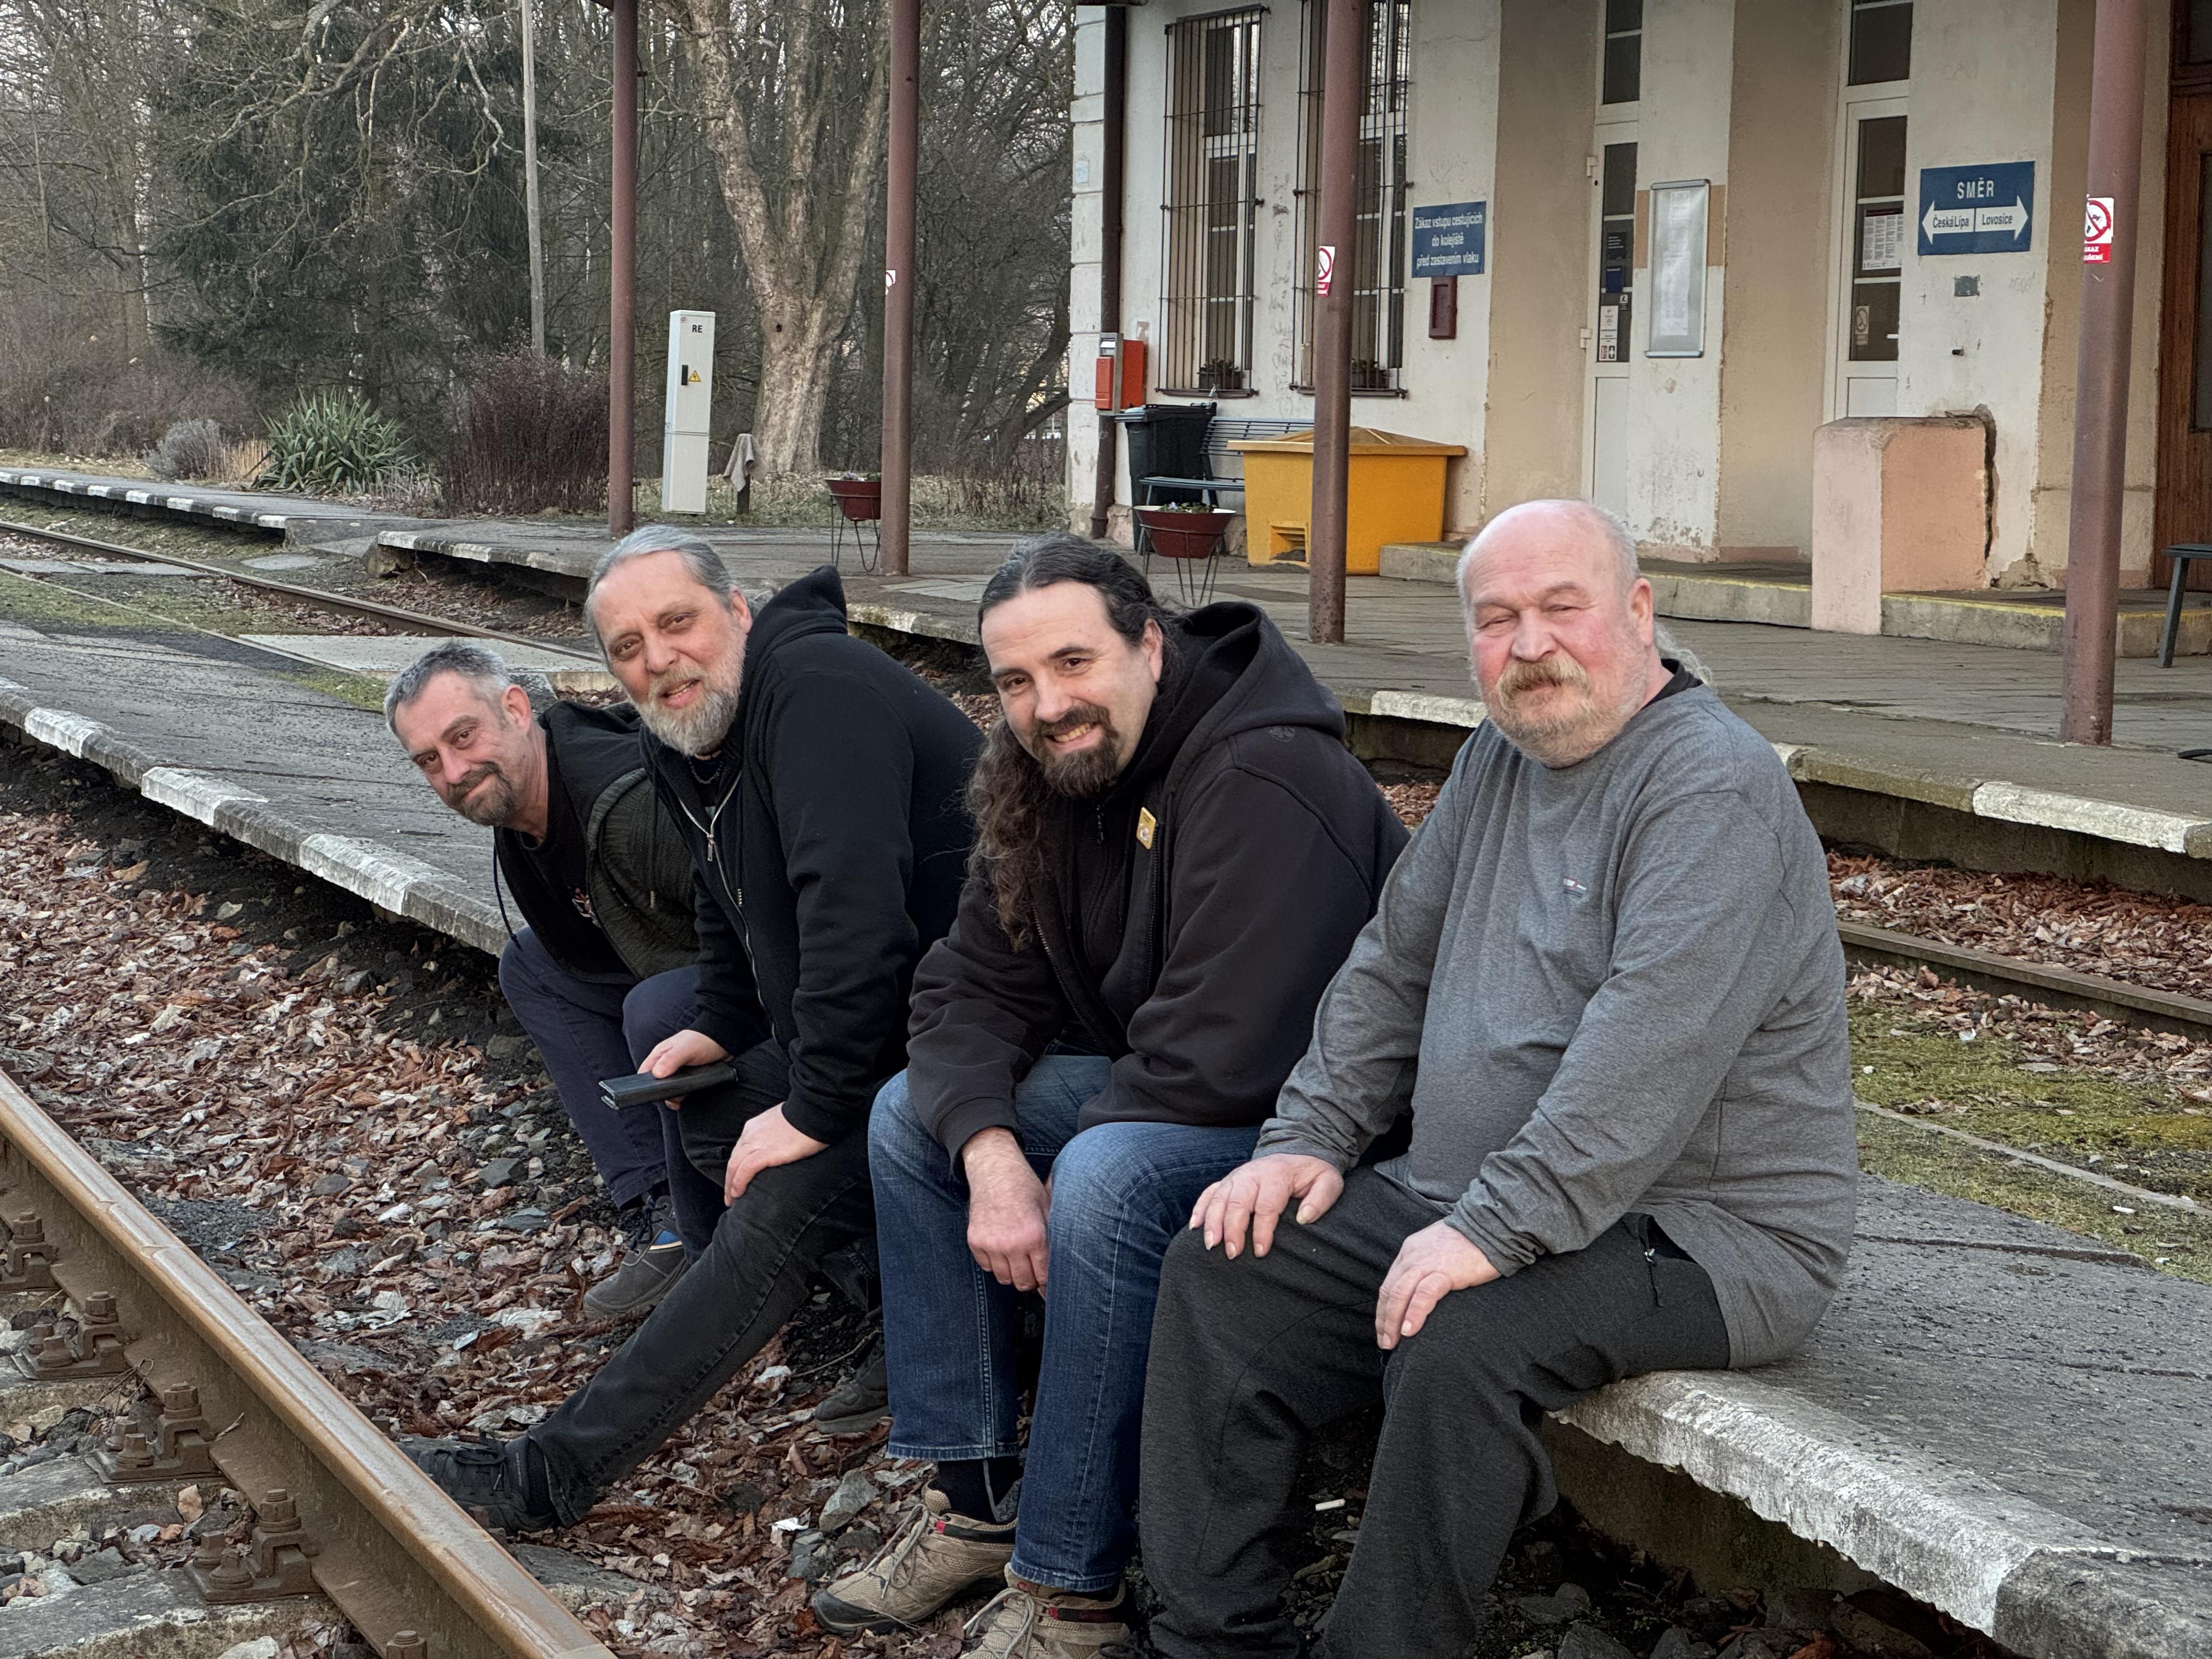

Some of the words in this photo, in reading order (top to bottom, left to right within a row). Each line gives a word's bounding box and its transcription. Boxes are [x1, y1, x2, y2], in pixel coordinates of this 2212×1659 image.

[1957, 177, 1994, 199] SMĚR
[1415, 216, 1431, 229] Zákaz
[1432, 216, 1451, 229] vstupu
[1933, 215, 1954, 228] Česká
[1954, 215, 1969, 229] Lípa
[1981, 212, 2013, 226] Lovosice
[1432, 235, 1439, 247] do
[1462, 251, 1479, 263] vlaku
[692, 325, 703, 333] RE
